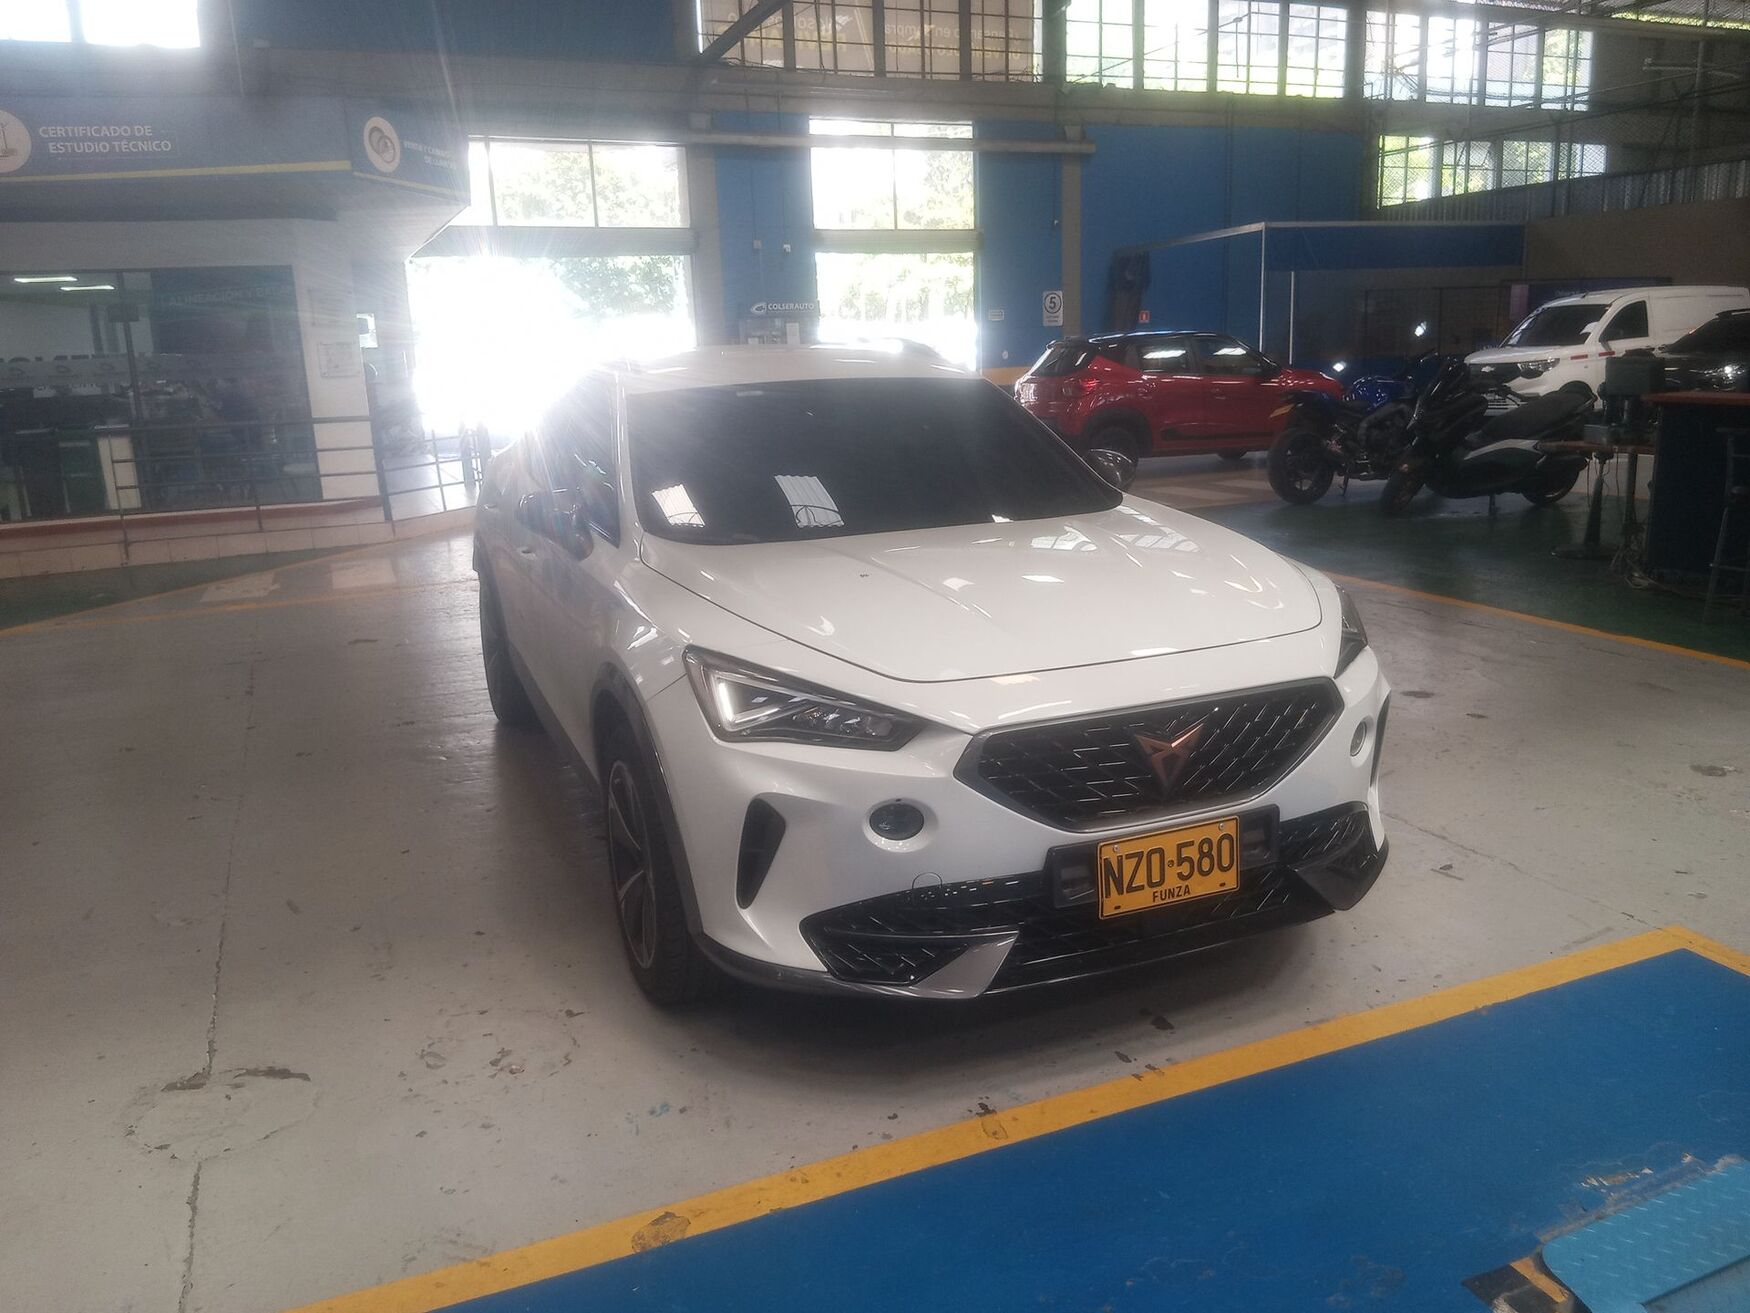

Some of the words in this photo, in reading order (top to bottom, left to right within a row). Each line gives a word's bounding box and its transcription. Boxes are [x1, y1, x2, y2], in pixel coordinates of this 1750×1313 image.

[39, 125, 131, 138] CERTIFICADO
[134, 125, 153, 137] DE
[48, 141, 110, 154] ESTUDIO
[112, 138, 172, 153] TÉCNICO
[768, 302, 815, 311] COLSERAUTO
[1048, 296, 1057, 310] 5
[1152, 886, 1191, 903] FUNZA
